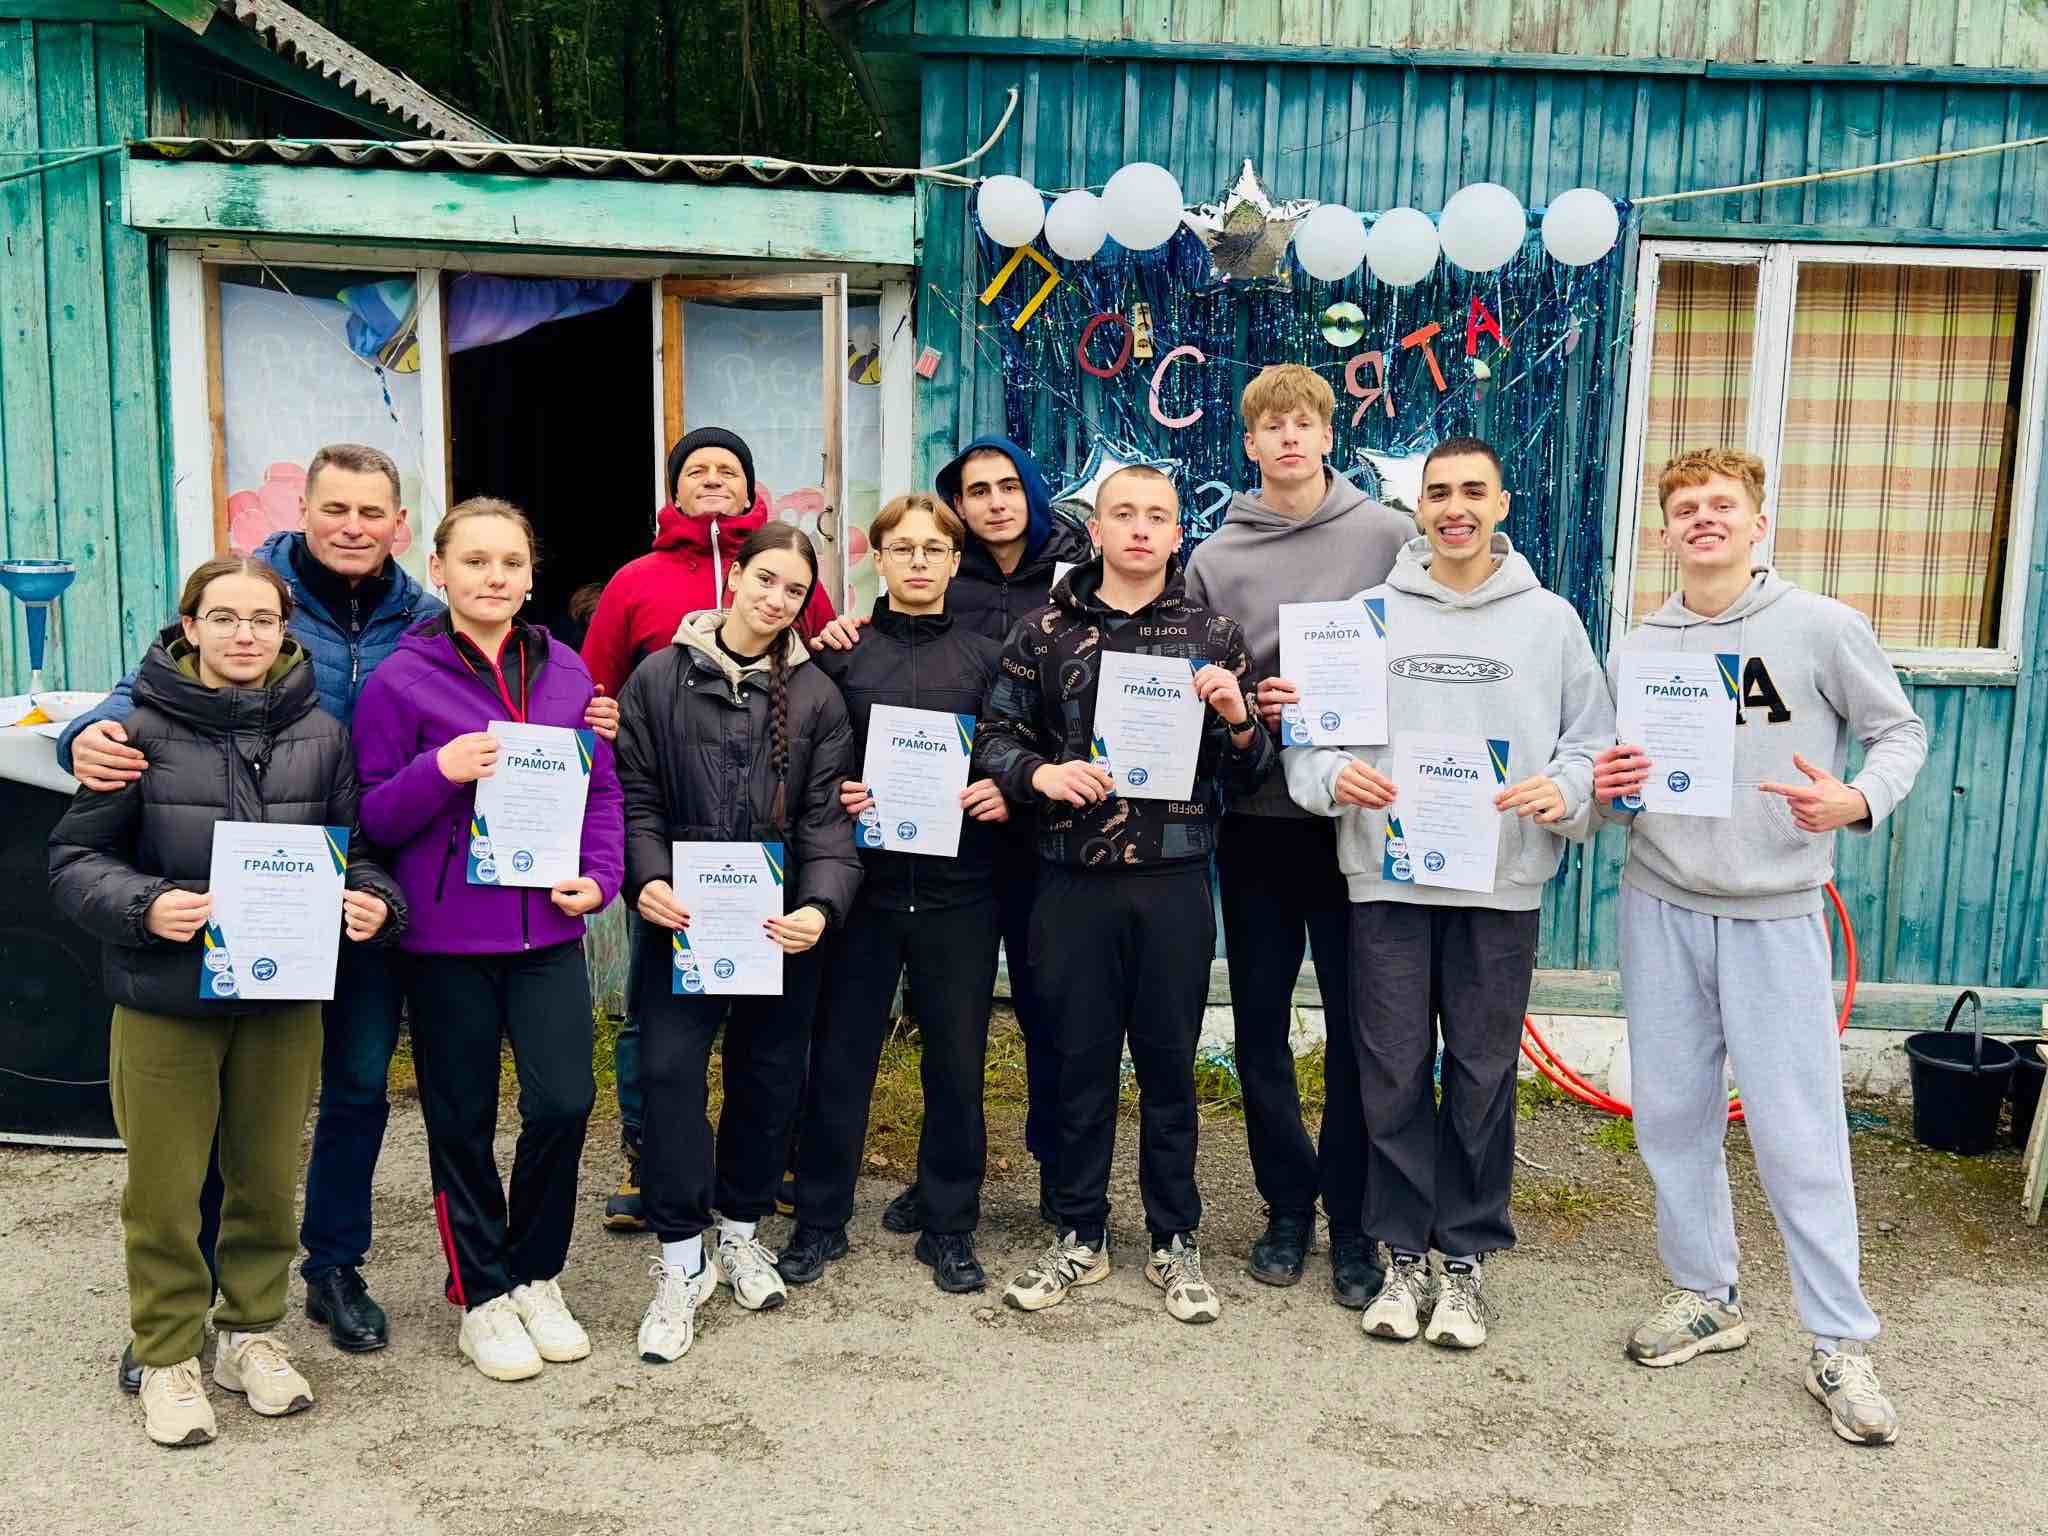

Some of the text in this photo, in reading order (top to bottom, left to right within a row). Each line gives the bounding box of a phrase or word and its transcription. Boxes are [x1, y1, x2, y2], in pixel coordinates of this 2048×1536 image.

[980, 244, 1512, 428] ПОСЯТА
[1305, 630, 1361, 641] ГРАМОТА
[1124, 684, 1182, 699] ГРАМОТА
[1646, 685, 1709, 698] ГРАМОТА
[892, 736, 947, 753] ГРАМОТА
[507, 756, 566, 771] ГРАМОТА
[1420, 765, 1479, 780] ГРАМОТА
[244, 859, 315, 873] ГРАМОТА
[700, 874, 758, 885] ГРАМОТА
